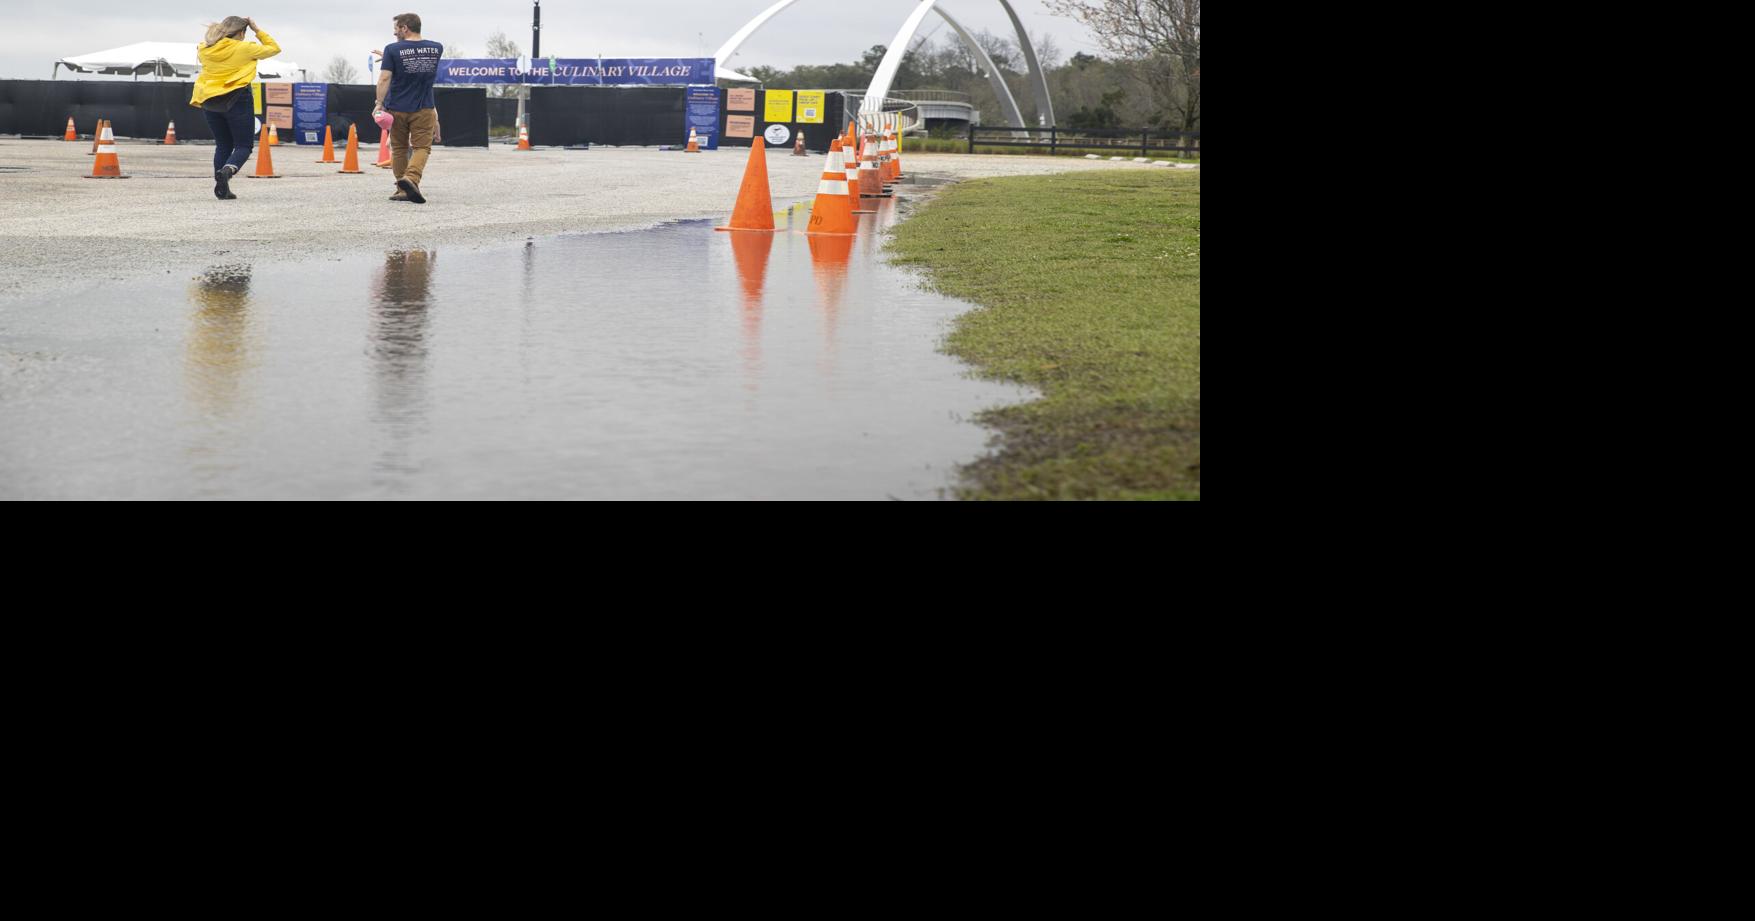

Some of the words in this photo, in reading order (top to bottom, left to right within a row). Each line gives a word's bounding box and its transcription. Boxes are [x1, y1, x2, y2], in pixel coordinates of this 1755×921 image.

[448, 67, 504, 76] WELCOME
[508, 68, 522, 76] TO
[526, 67, 548, 76] THE
[552, 66, 625, 76] CULINARY
[628, 66, 690, 76] VILLAGE
